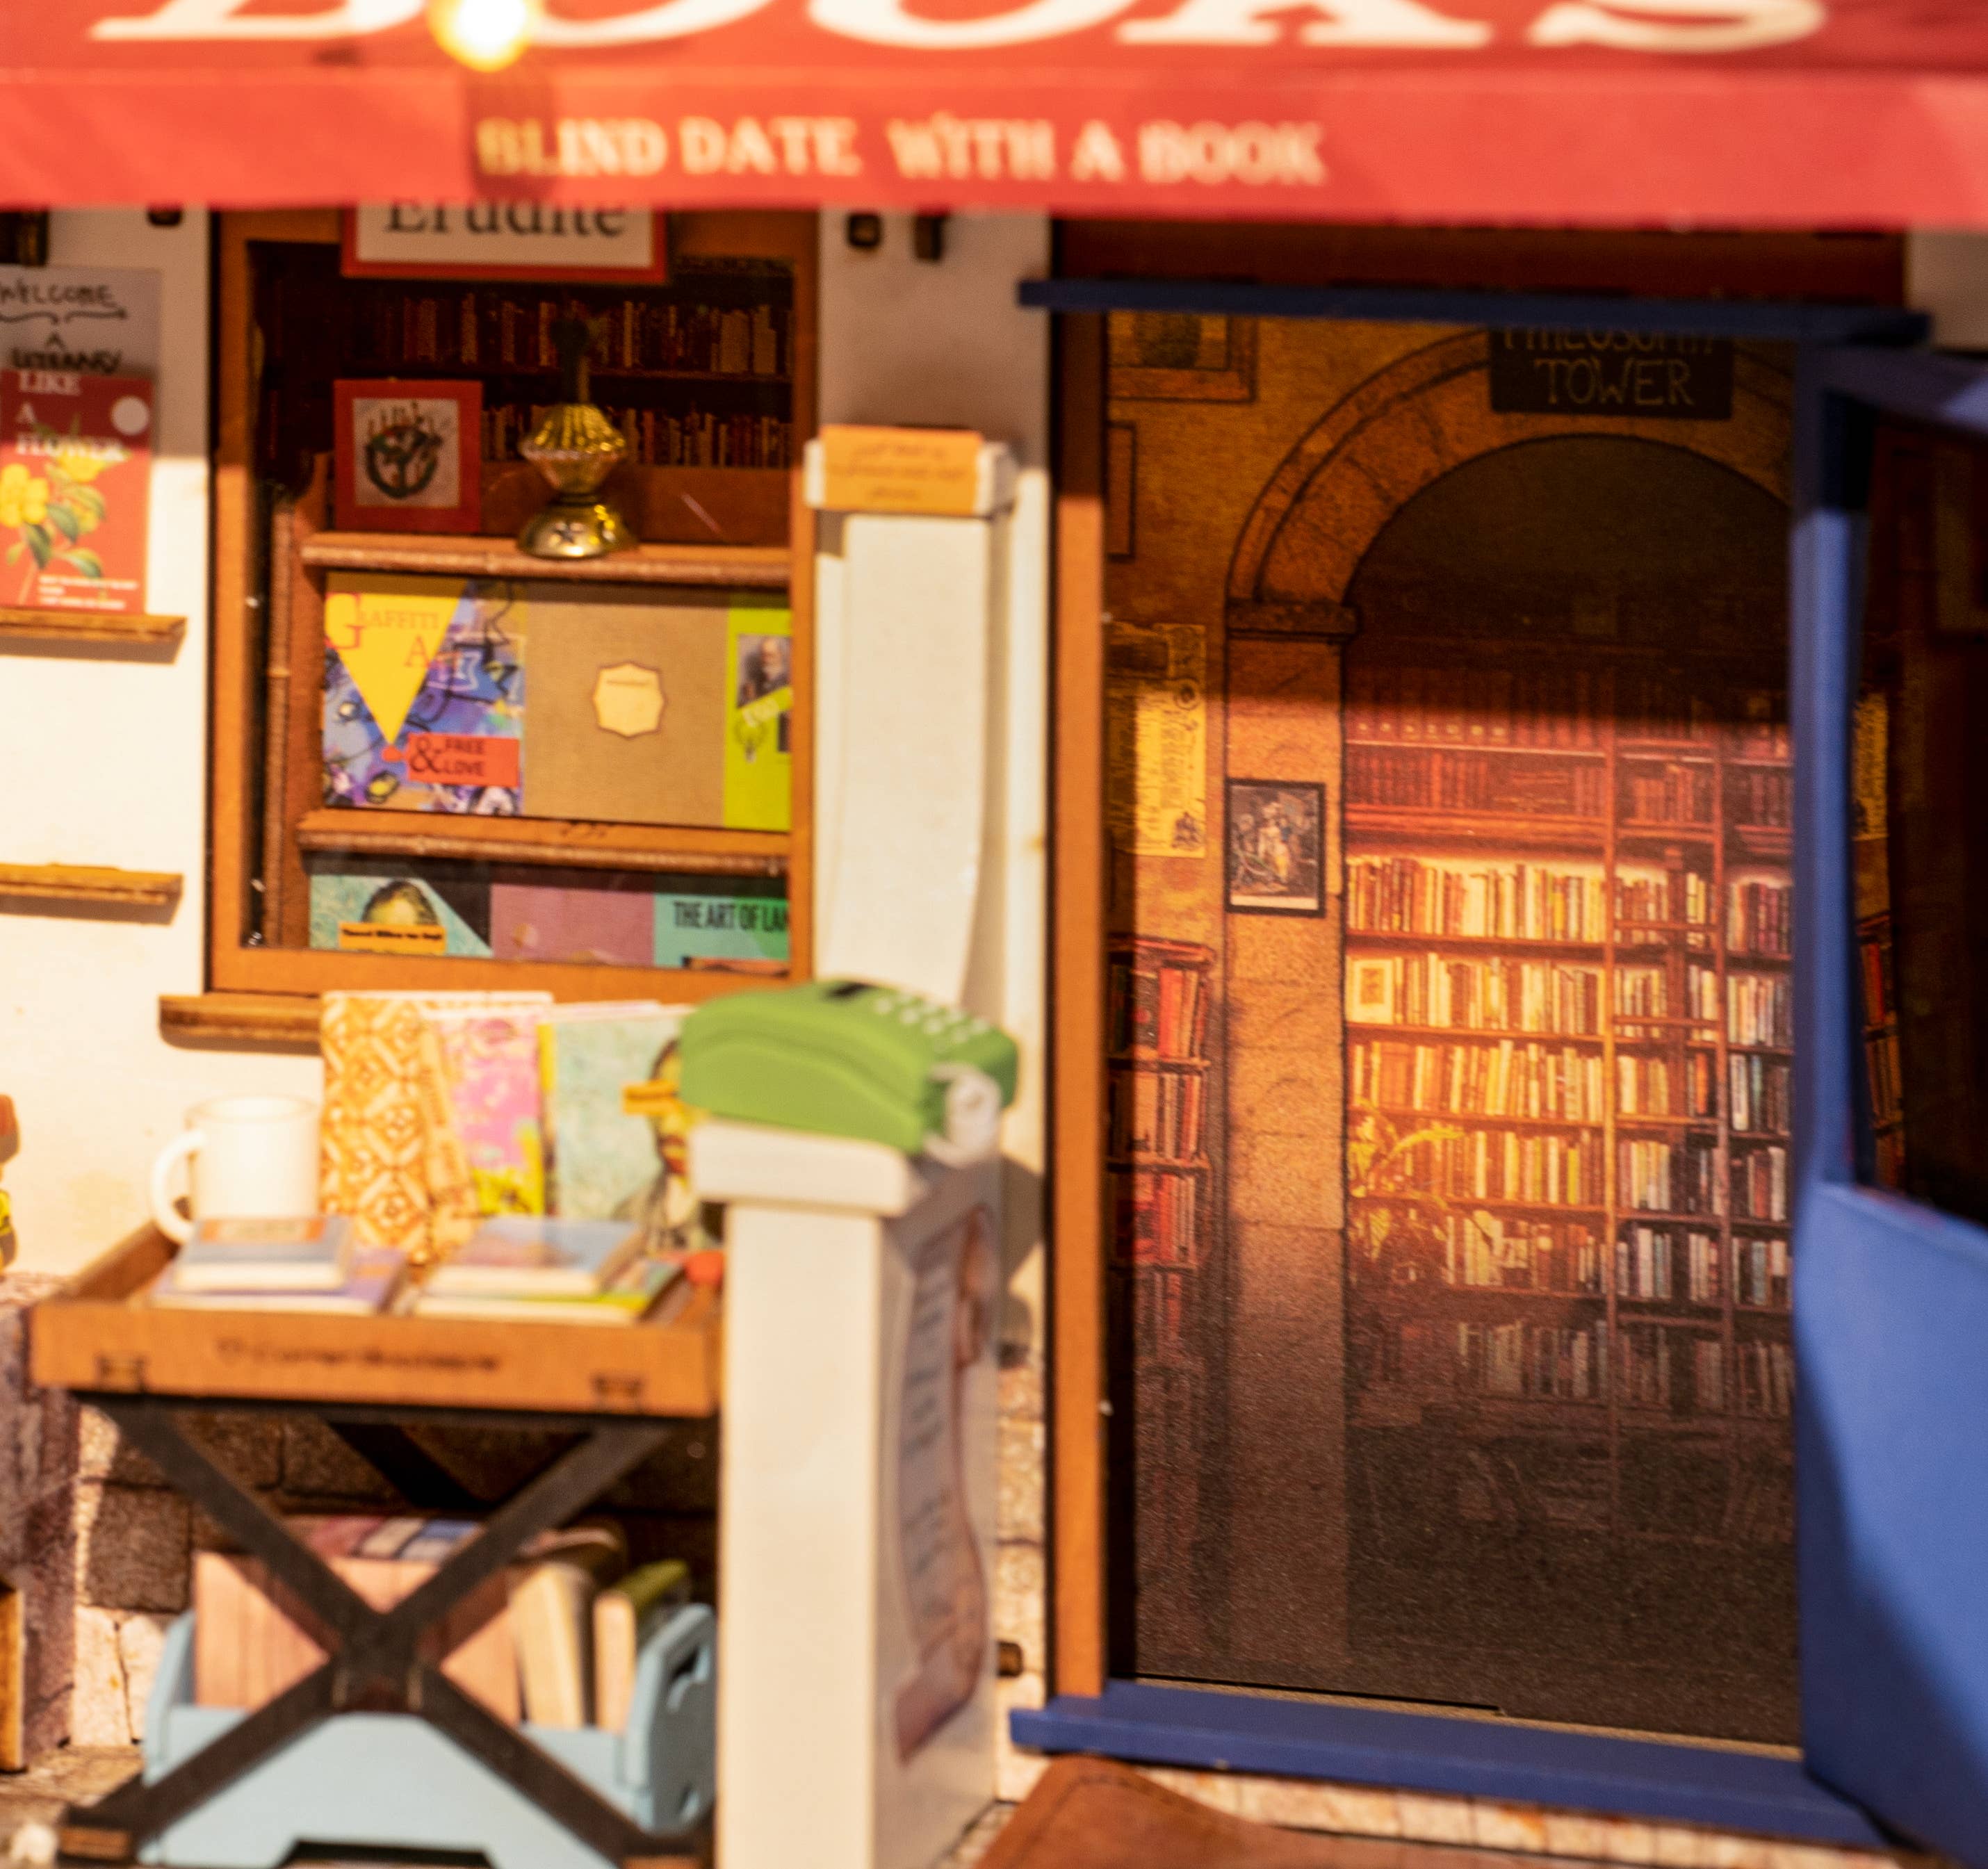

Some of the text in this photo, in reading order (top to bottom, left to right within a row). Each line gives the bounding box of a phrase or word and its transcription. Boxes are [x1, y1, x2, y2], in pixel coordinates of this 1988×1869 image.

[475, 111, 1328, 188] BLIND DATE WITH A BOOK
[1533, 355, 1696, 407] TOWER
[16, 400, 37, 425] A
[672, 901, 701, 929] THE
[704, 903, 735, 931] ART
[738, 904, 758, 932] OF
